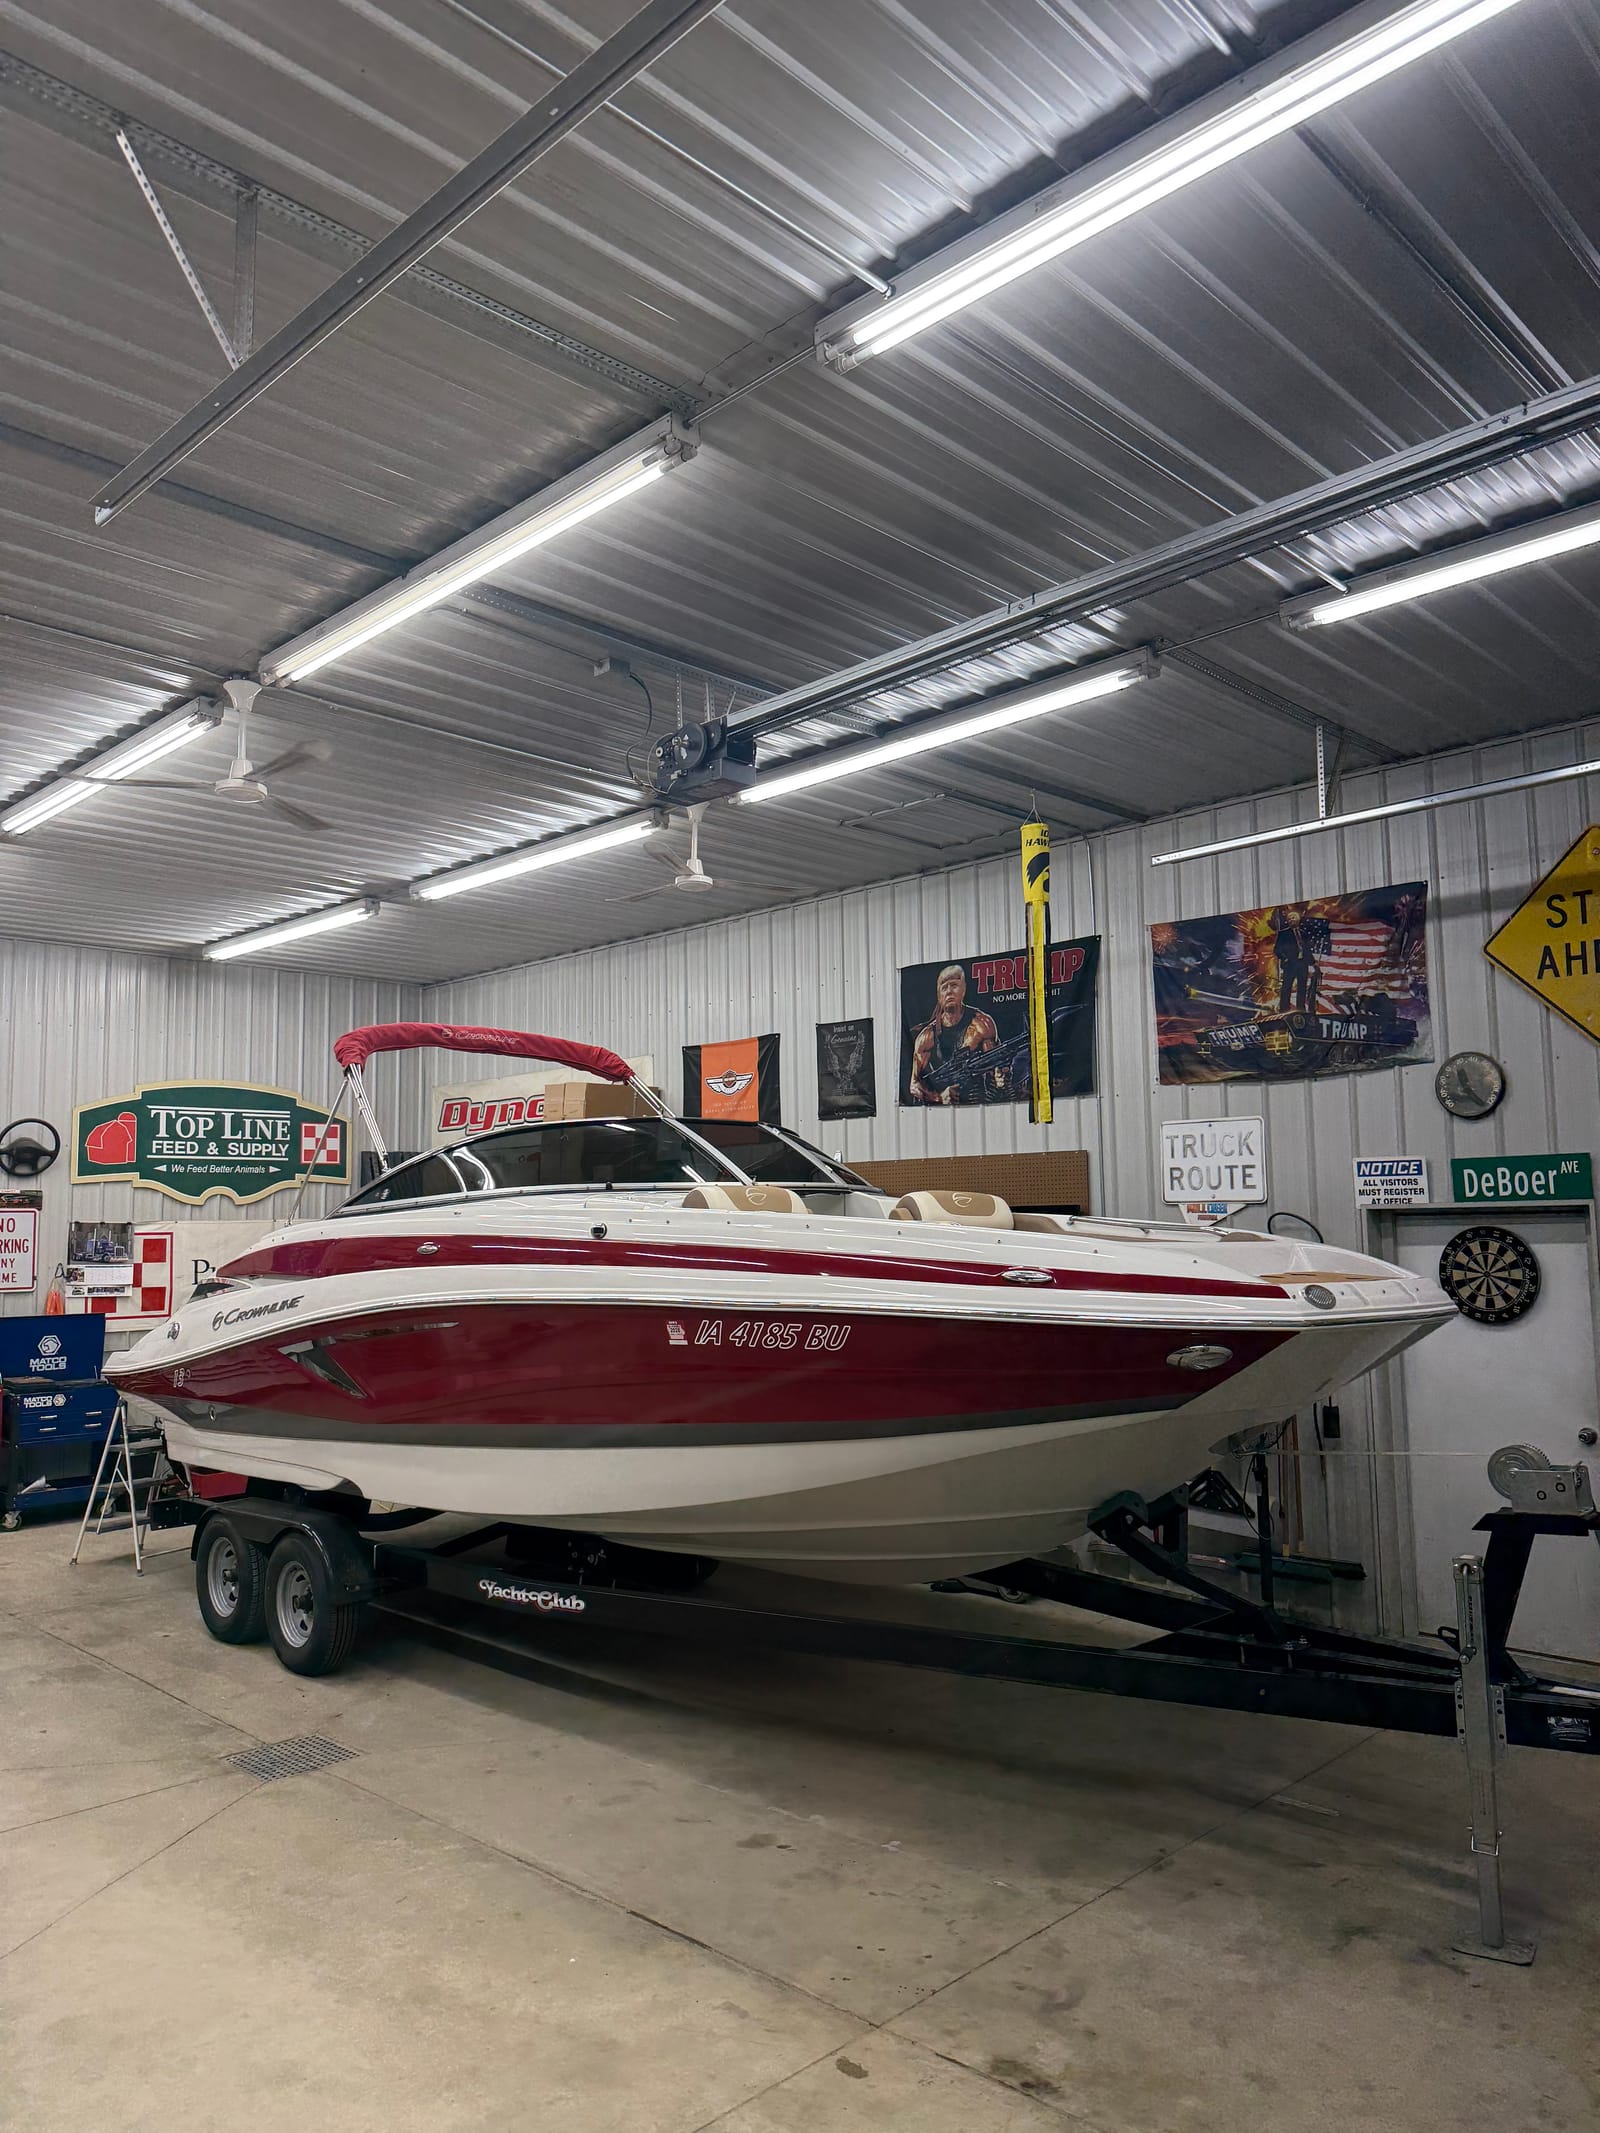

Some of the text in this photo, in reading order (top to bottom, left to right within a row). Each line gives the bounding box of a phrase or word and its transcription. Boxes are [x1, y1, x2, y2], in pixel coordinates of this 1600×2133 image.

[992, 995, 1005, 1004] NO
[1005, 992, 1027, 1002] MORE
[1208, 1024, 1258, 1041] TRUMP
[1319, 1017, 1368, 1040] TRUMP
[150, 1109, 291, 1141] TOP LINE
[152, 1140, 289, 1157] FEED & SUPPLY
[1165, 1130, 1255, 1159] TRUCK
[171, 1164, 266, 1174] We Feed Better Animals
[1360, 1161, 1420, 1176] NOTICE
[1169, 1164, 1257, 1191] ROUTE
[1363, 1178, 1419, 1187] ALL VISITORS
[1463, 1160, 1580, 1198] DeBoer AVE
[1358, 1187, 1425, 1197] MUST REGISTER
[1371, 1197, 1413, 1205] AT OFFICE
[694, 1319, 723, 1346] IA
[728, 1321, 802, 1349] 4185
[805, 1324, 851, 1350] BU
[29, 1356, 67, 1367] MATCO
[29, 1363, 66, 1372] TOOLS
